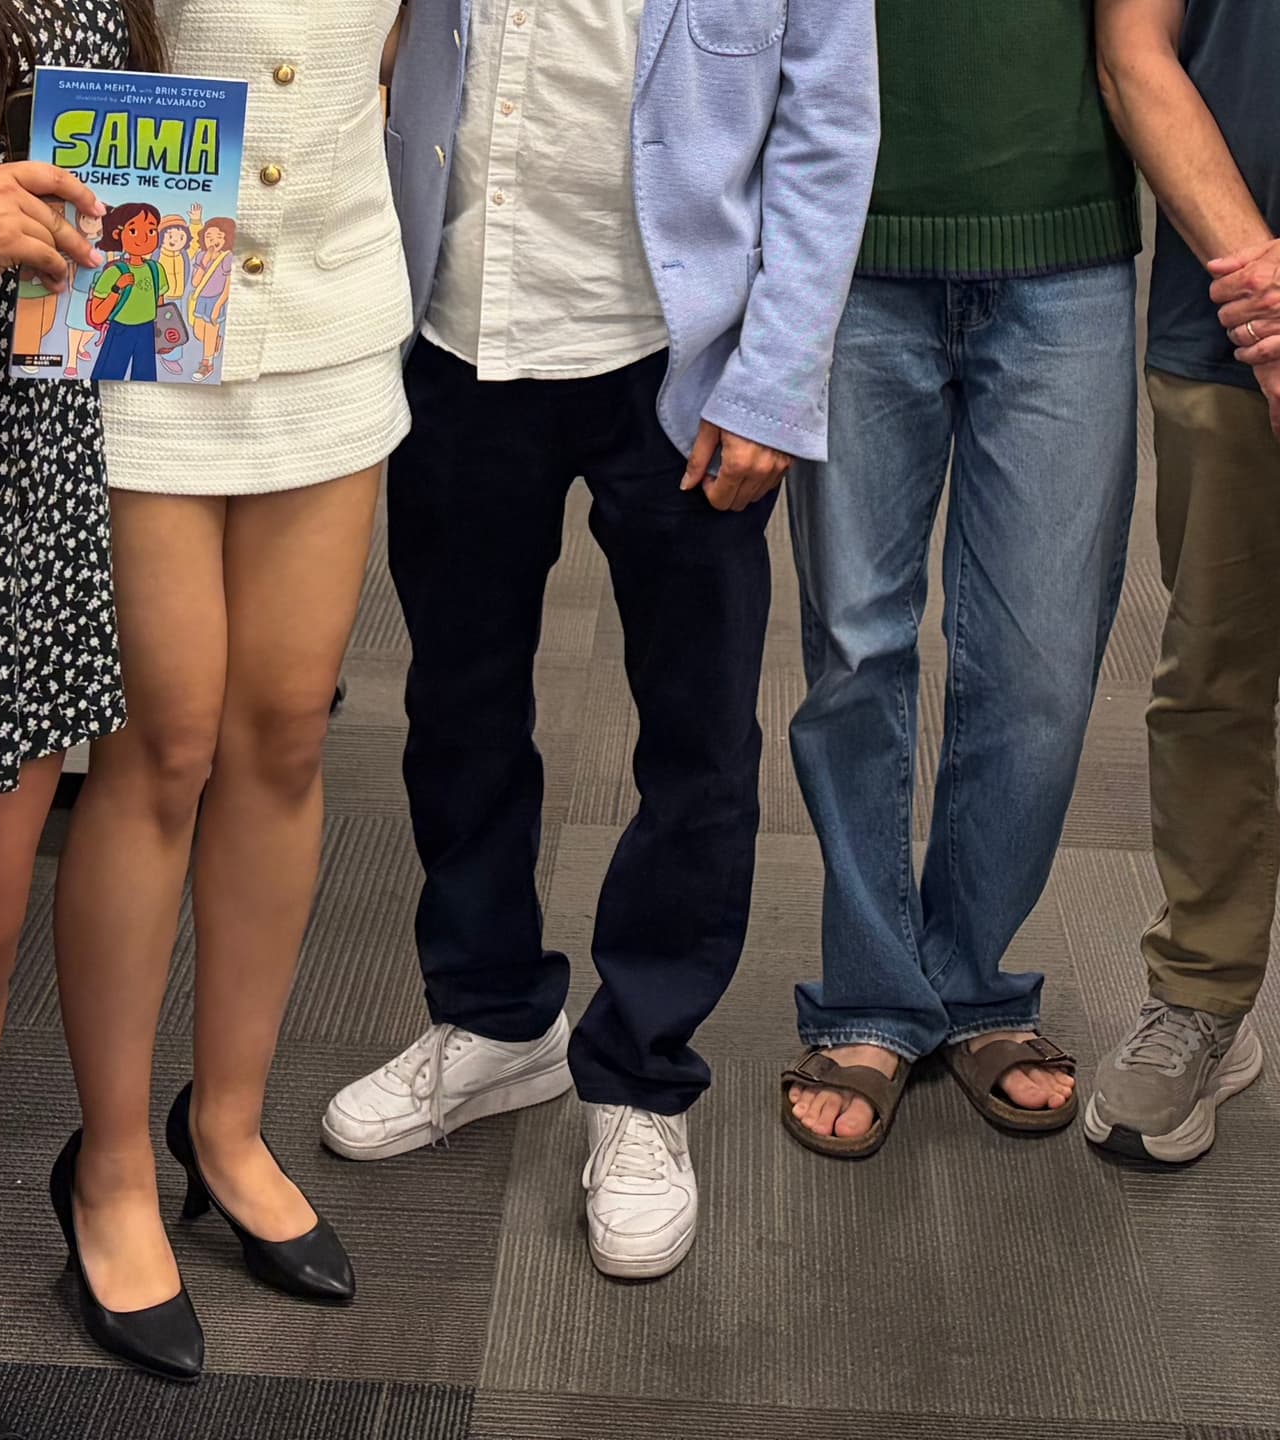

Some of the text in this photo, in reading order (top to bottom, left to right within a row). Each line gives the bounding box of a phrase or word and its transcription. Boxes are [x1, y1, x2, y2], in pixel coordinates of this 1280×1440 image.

[58, 80, 226, 100] SAMAIRA MEHTA BRIN STEVENS
[120, 95, 207, 108] JENNY ALVARADO
[52, 108, 219, 176] SAMA
[137, 176, 213, 192] THE CODE
